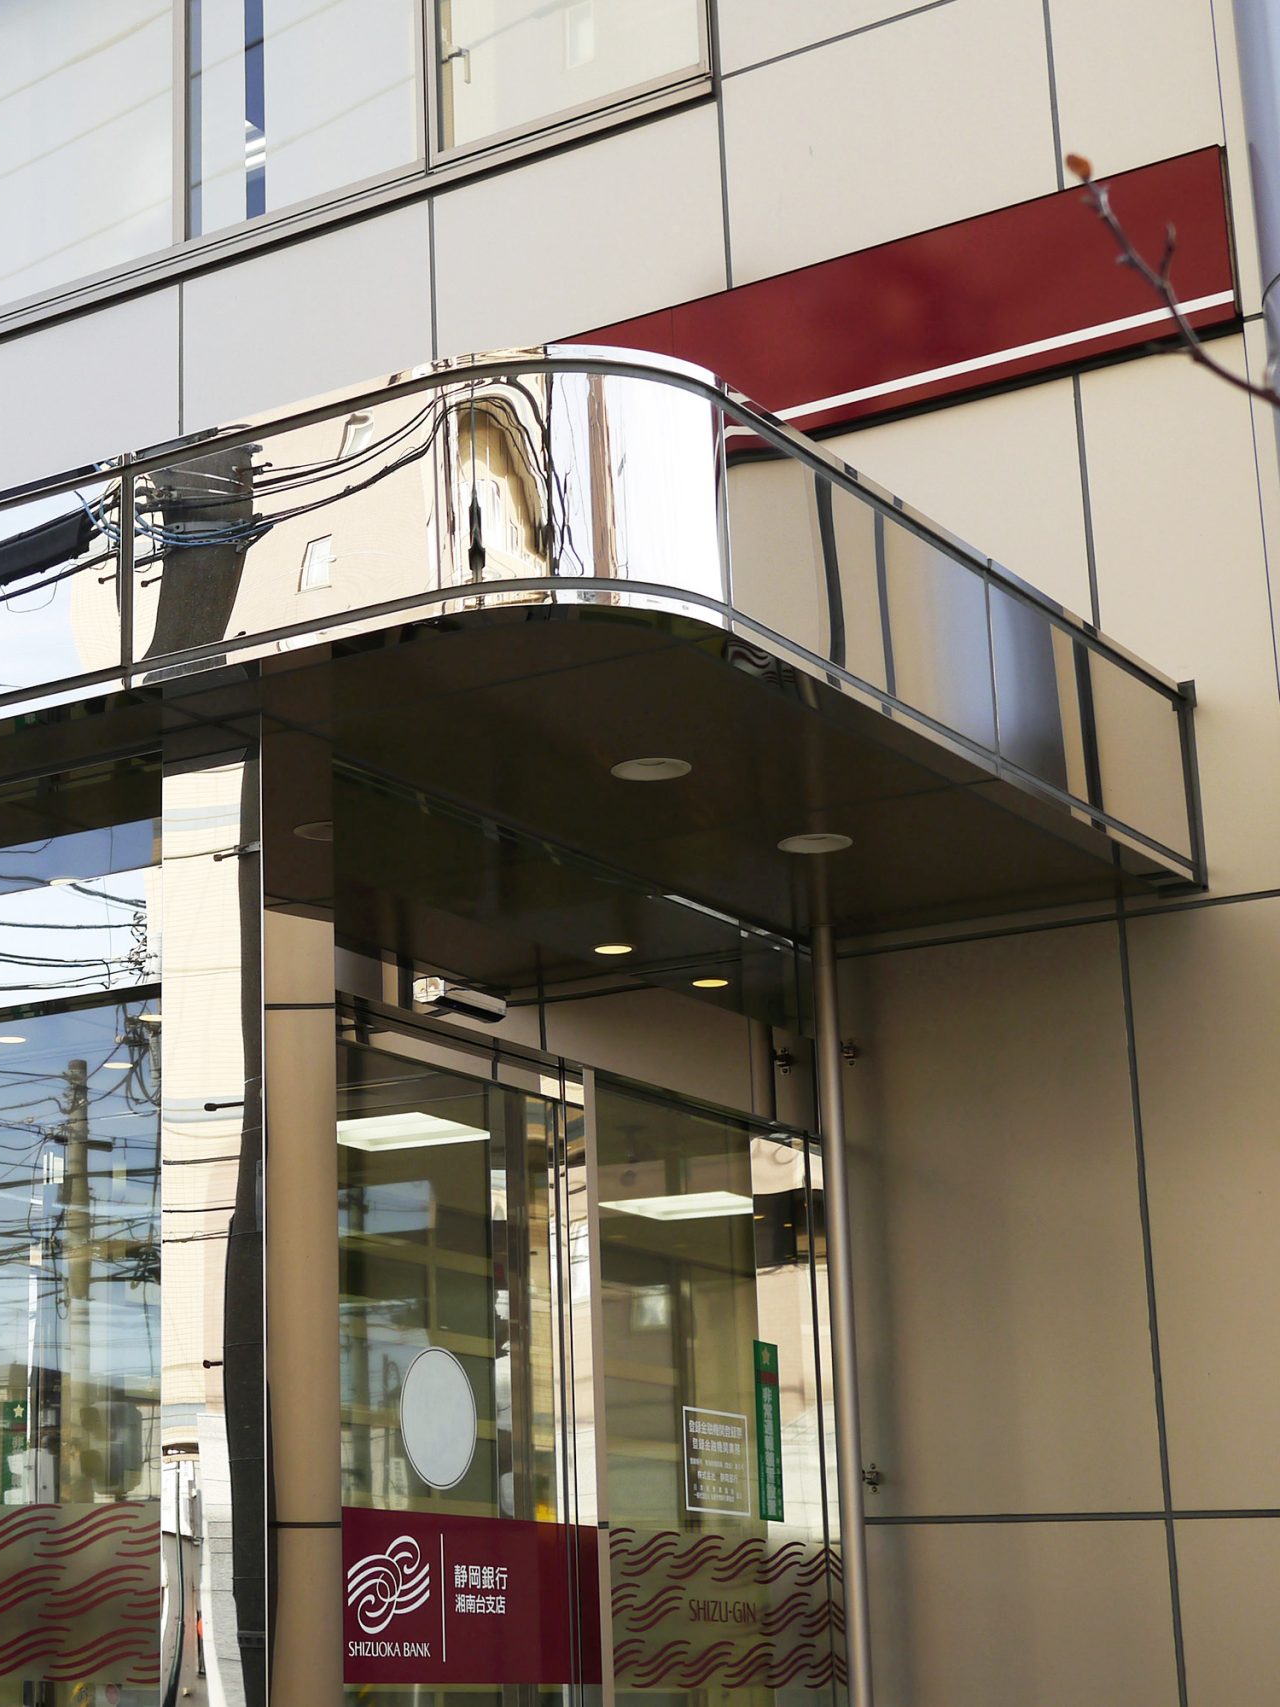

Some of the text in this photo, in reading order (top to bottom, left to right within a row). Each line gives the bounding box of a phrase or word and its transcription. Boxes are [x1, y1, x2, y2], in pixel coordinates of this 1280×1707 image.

[454, 1565, 509, 1590] 静岡銀行
[455, 1594, 506, 1615] 湘南台支店
[689, 1599, 757, 1624] SHIZU-GIN
[348, 1641, 431, 1658] SHIZUOKA BANK
